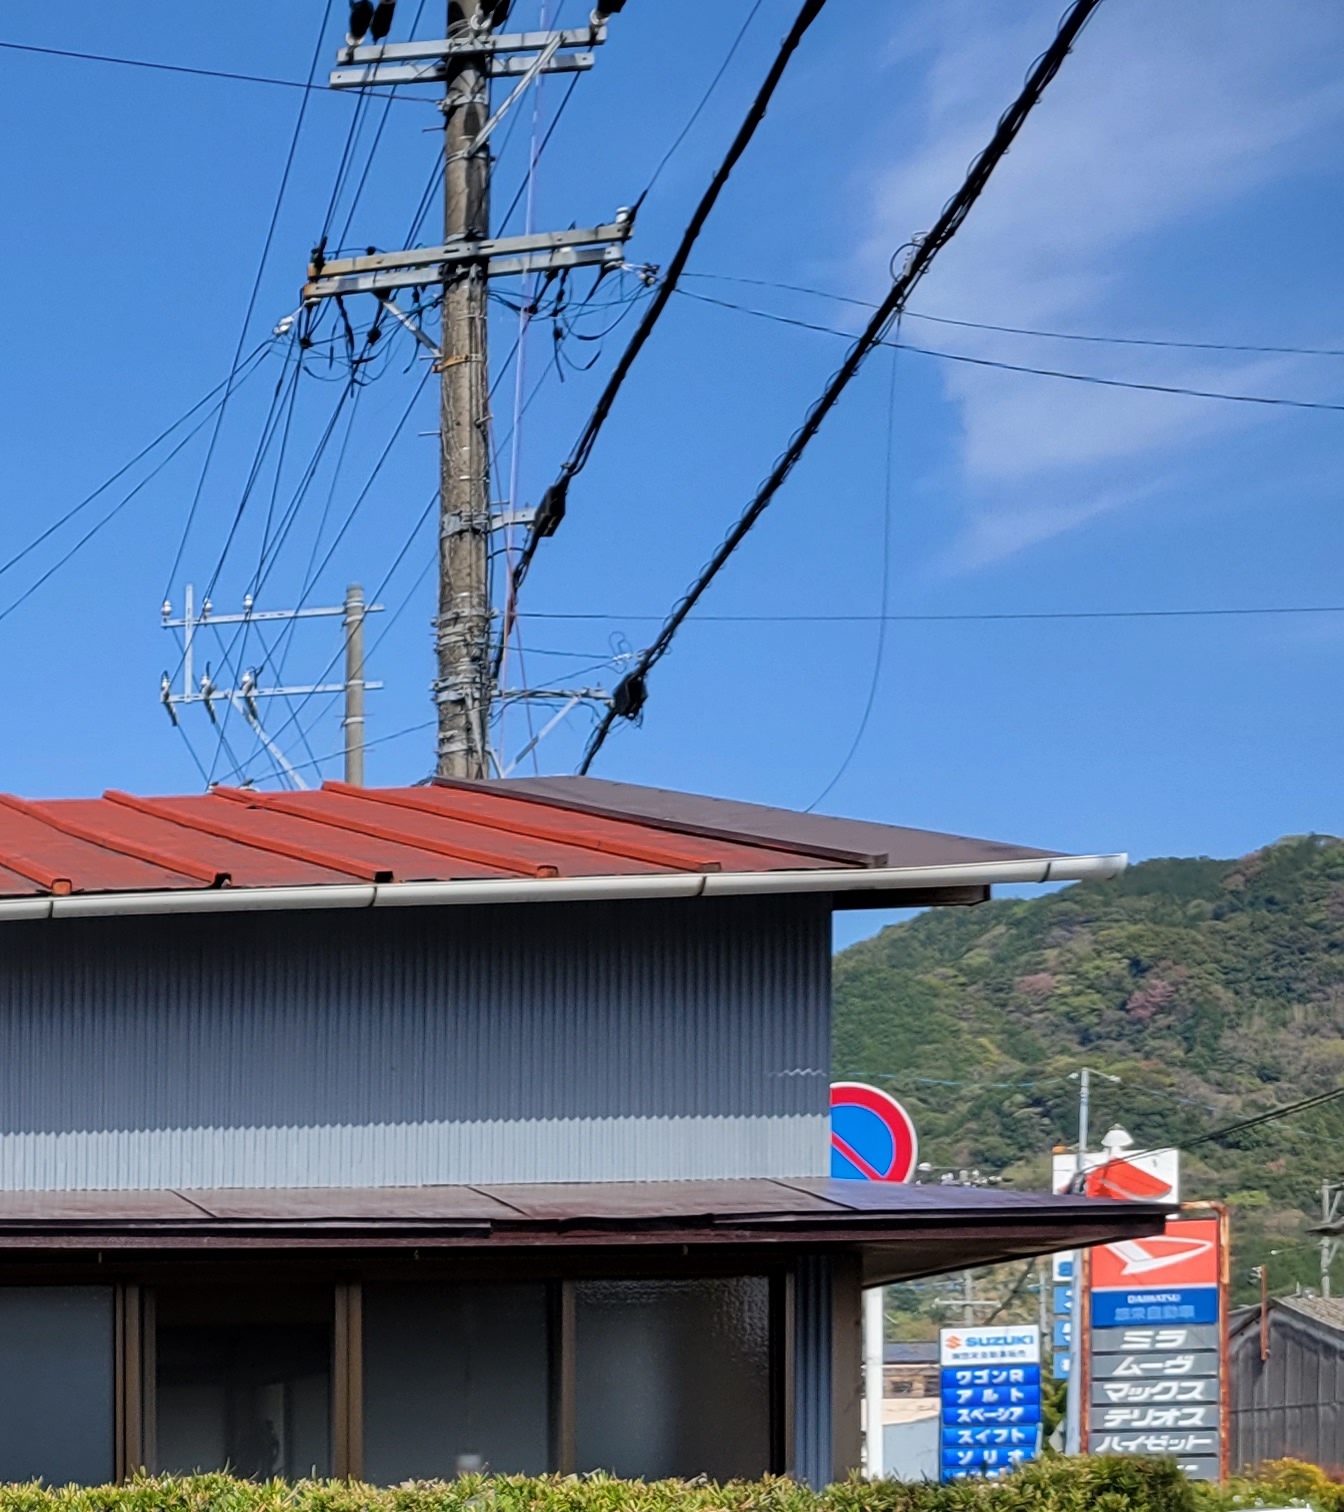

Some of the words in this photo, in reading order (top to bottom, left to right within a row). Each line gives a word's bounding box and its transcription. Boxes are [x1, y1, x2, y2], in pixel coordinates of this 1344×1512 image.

[965, 1335, 1034, 1347] SUZUKI
[1120, 1330, 1187, 1349] ミラ
[1112, 1355, 1195, 1376] ムーヴ
[956, 1369, 1024, 1385] ワゴンR
[956, 1388, 1024, 1404] アルト
[1103, 1381, 1205, 1401] マックス
[1104, 1407, 1206, 1427] テリオス
[957, 1427, 1025, 1444] スイフト
[1095, 1435, 1212, 1452] ハイゼット
